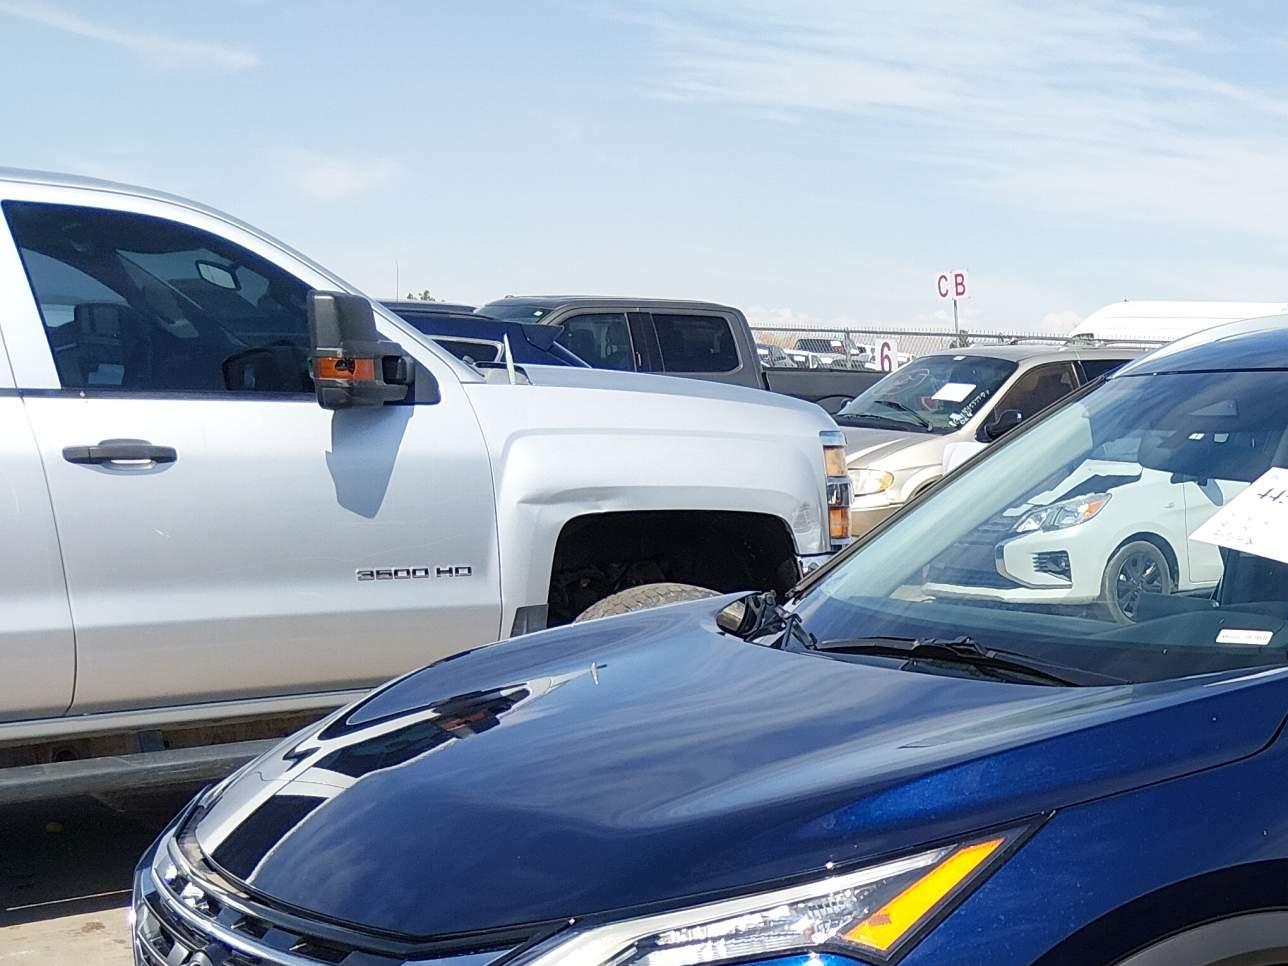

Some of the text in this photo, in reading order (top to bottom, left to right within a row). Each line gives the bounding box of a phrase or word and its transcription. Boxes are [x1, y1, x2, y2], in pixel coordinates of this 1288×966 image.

[938, 273, 966, 298] C B
[880, 341, 893, 373] 6
[436, 566, 472, 577] HD
